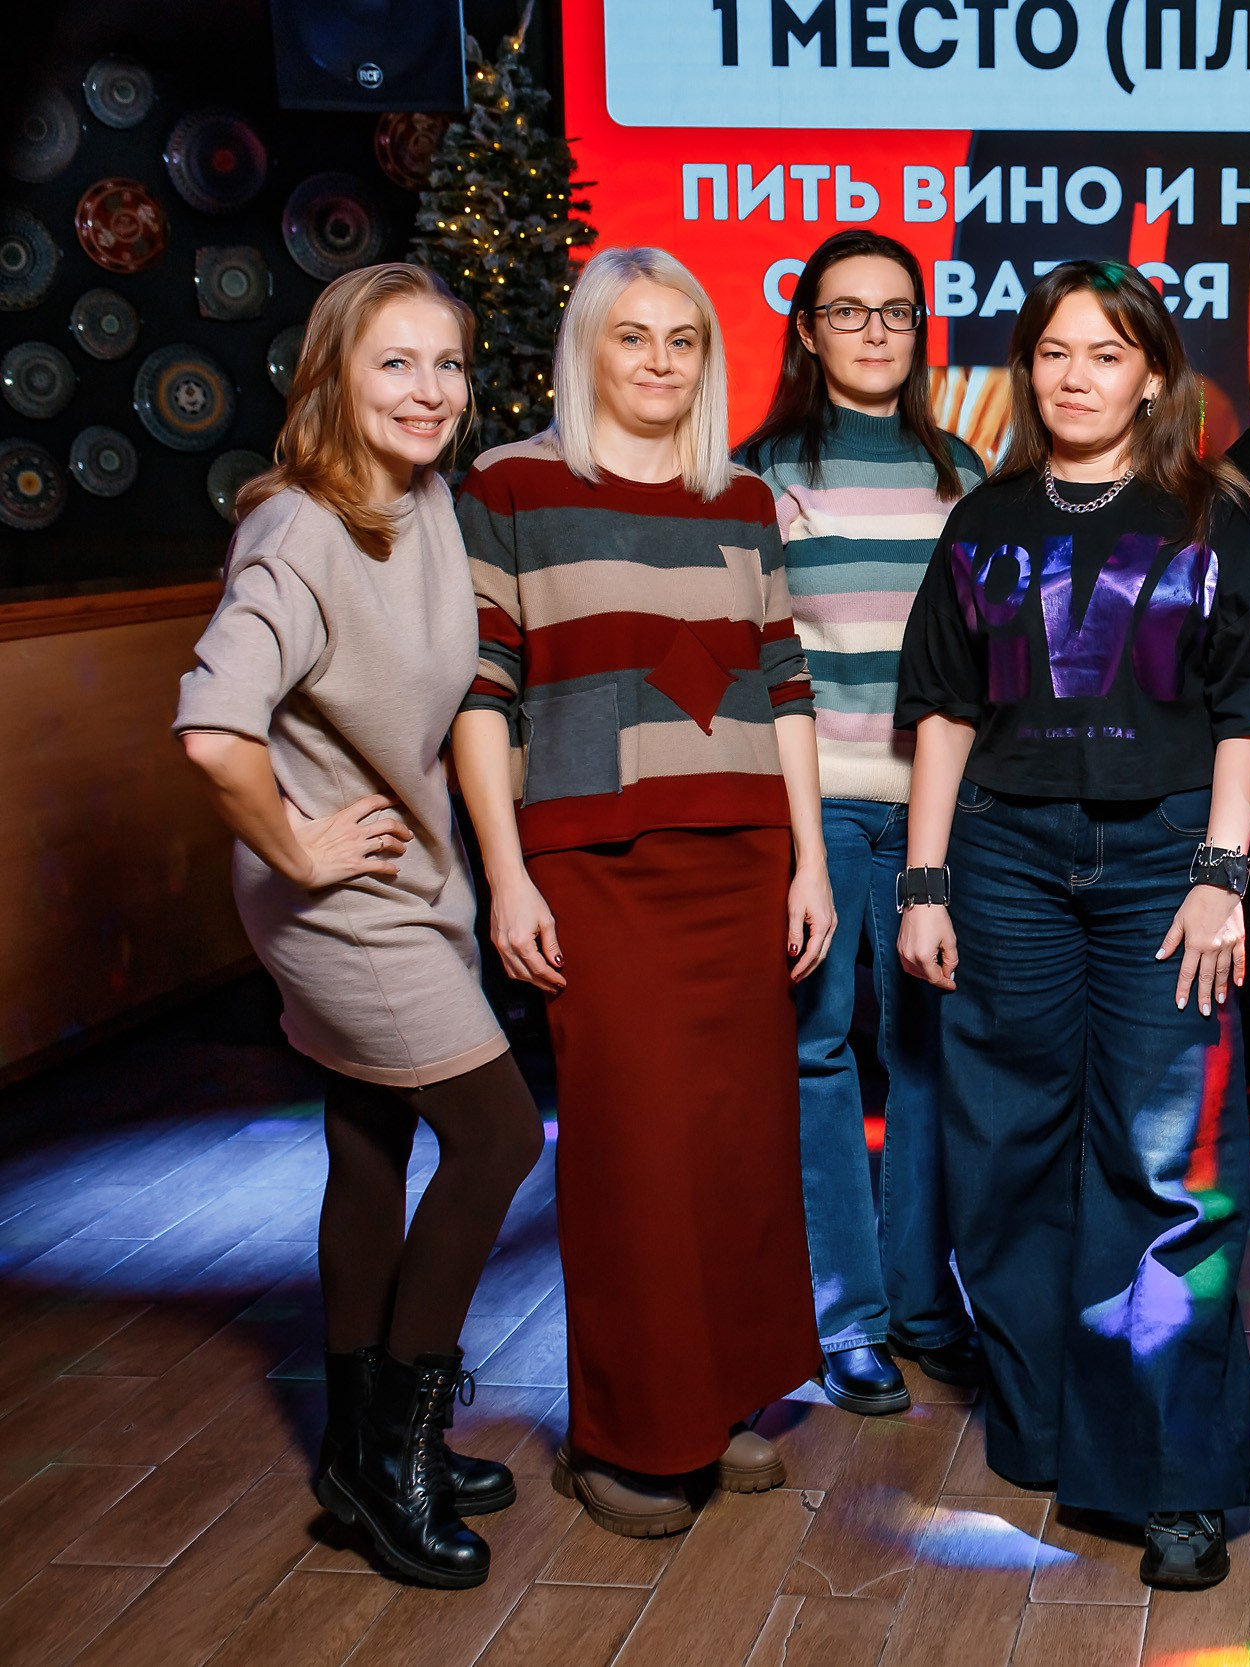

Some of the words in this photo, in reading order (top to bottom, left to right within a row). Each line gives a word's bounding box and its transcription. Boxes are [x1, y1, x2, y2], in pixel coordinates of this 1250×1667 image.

[712, 0, 739, 67] 1
[771, 0, 1079, 69] МЕСТО
[682, 163, 881, 223] ПИТЬ
[903, 164, 1122, 225] ВИНО
[1145, 166, 1195, 226] И
